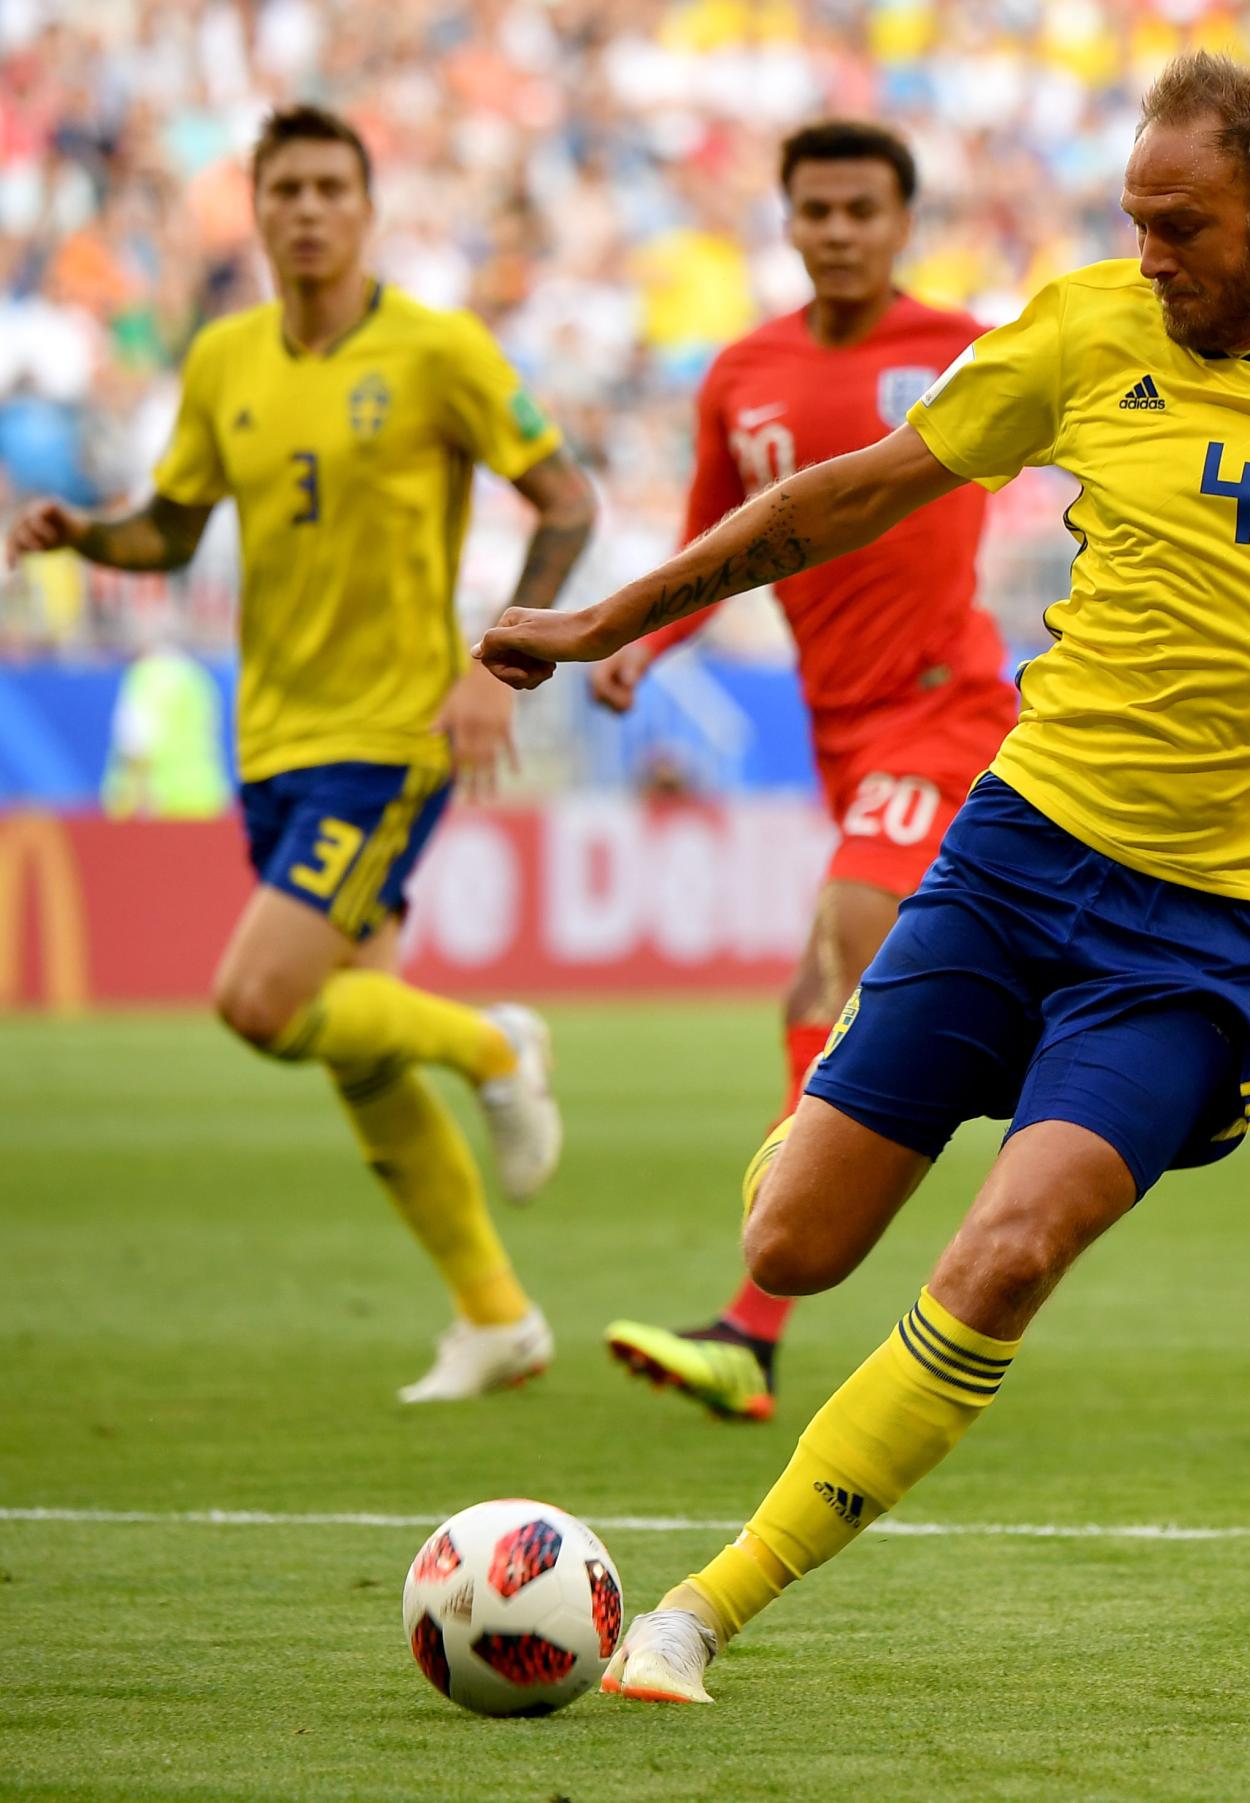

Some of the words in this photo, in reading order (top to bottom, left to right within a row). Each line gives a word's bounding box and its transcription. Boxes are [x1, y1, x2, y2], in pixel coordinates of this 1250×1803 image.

[1118, 397, 1166, 409] adidas
[291, 451, 319, 524] 3
[844, 770, 941, 845] 20
[290, 817, 362, 898] 3
[813, 1481, 861, 1529] adidas
